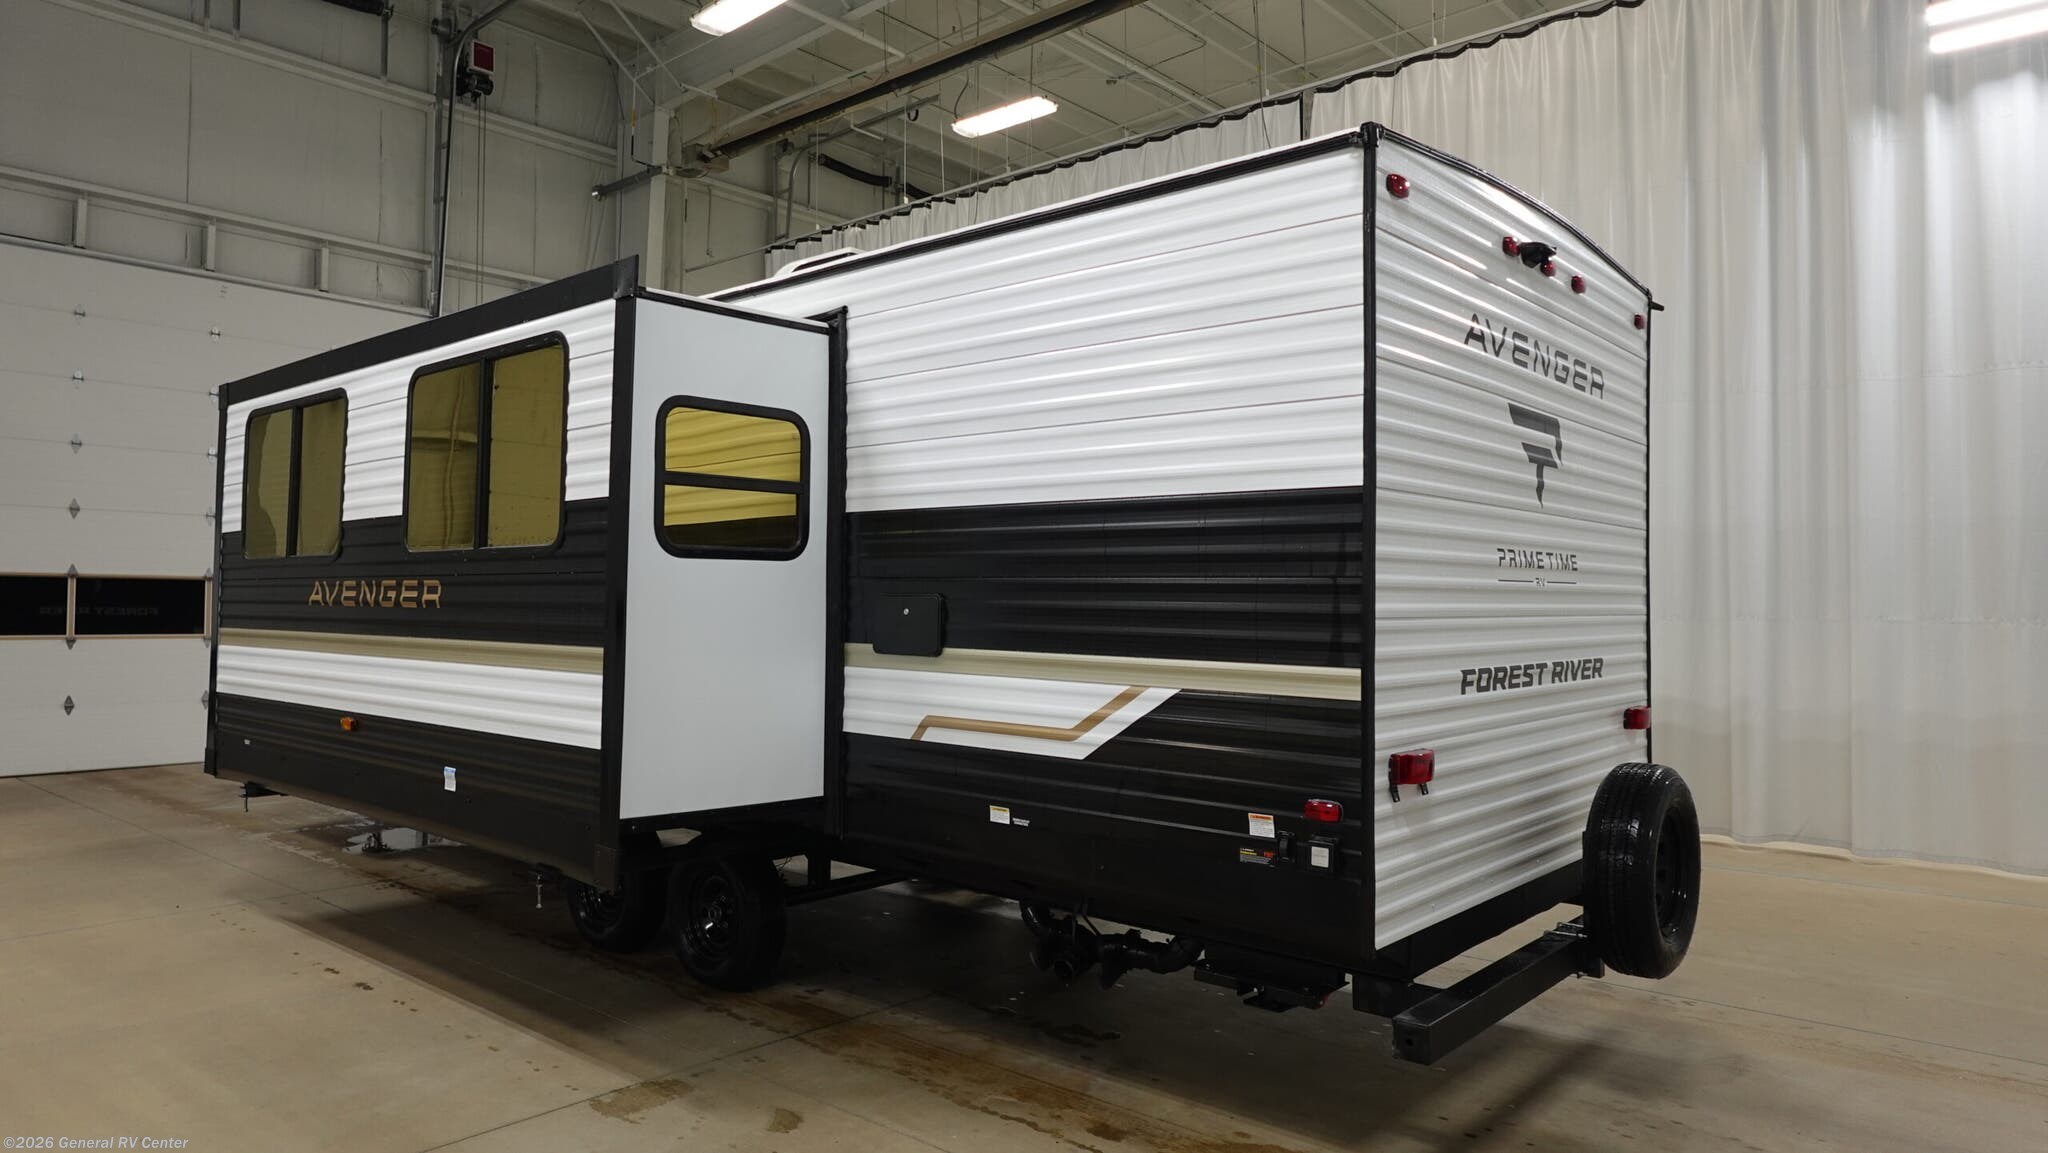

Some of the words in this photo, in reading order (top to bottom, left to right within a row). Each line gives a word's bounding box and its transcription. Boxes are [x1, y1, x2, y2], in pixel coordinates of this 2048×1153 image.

[1464, 313, 1604, 399] AVENGER
[308, 580, 441, 608] AVENGER
[1460, 662, 1548, 695] FOREST
[1551, 657, 1604, 684] RIVER
